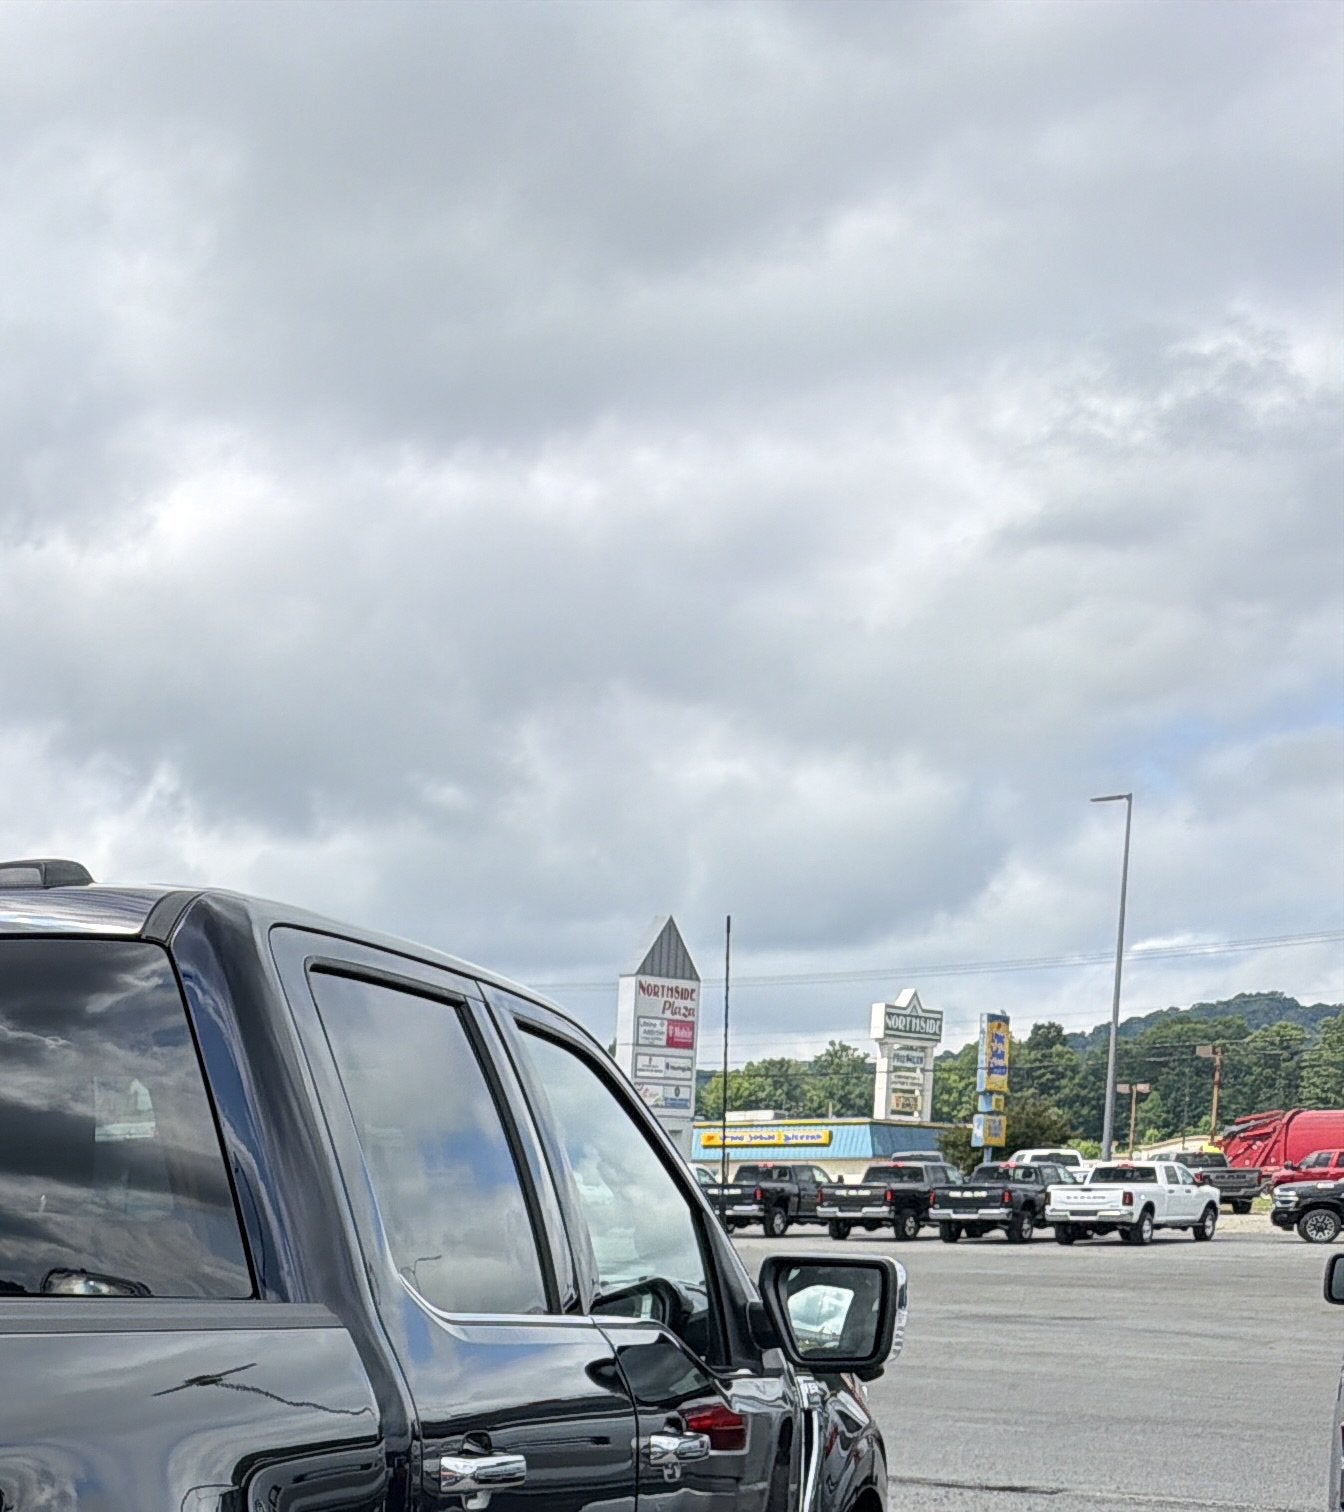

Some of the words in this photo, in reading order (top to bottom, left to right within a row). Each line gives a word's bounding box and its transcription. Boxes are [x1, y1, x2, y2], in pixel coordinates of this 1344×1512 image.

[638, 979, 696, 1001] NORTHSIDE
[661, 1000, 696, 1018] Plaza
[885, 1014, 941, 1034] NORTHSIDE
